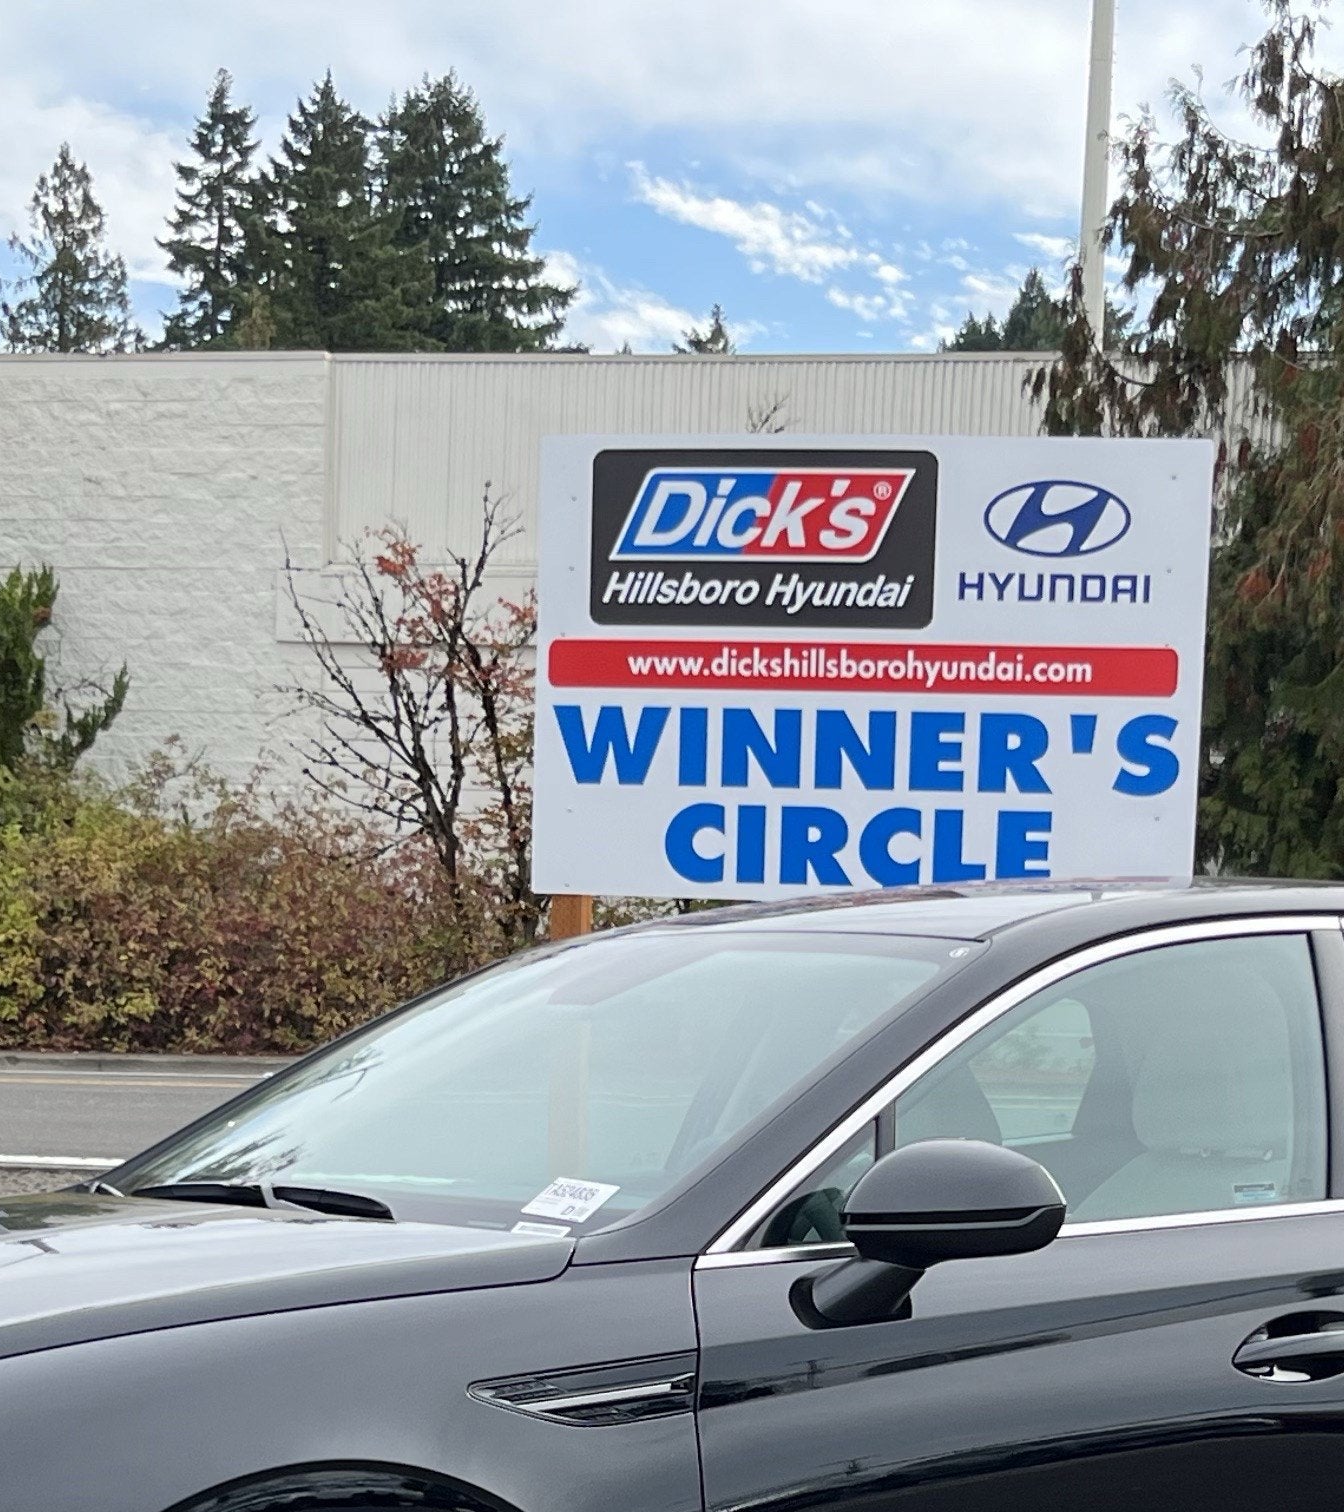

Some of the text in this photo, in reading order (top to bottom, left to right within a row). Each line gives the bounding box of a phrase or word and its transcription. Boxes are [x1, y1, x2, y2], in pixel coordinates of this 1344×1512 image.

[601, 571, 916, 614] Hillsboro Hyundai
[958, 571, 1152, 604] HYUNDAI
[626, 647, 1094, 688] www.dickshillsborohyundai.com
[553, 704, 1181, 798] WINNER'S
[665, 802, 1053, 888] CIRCLE
